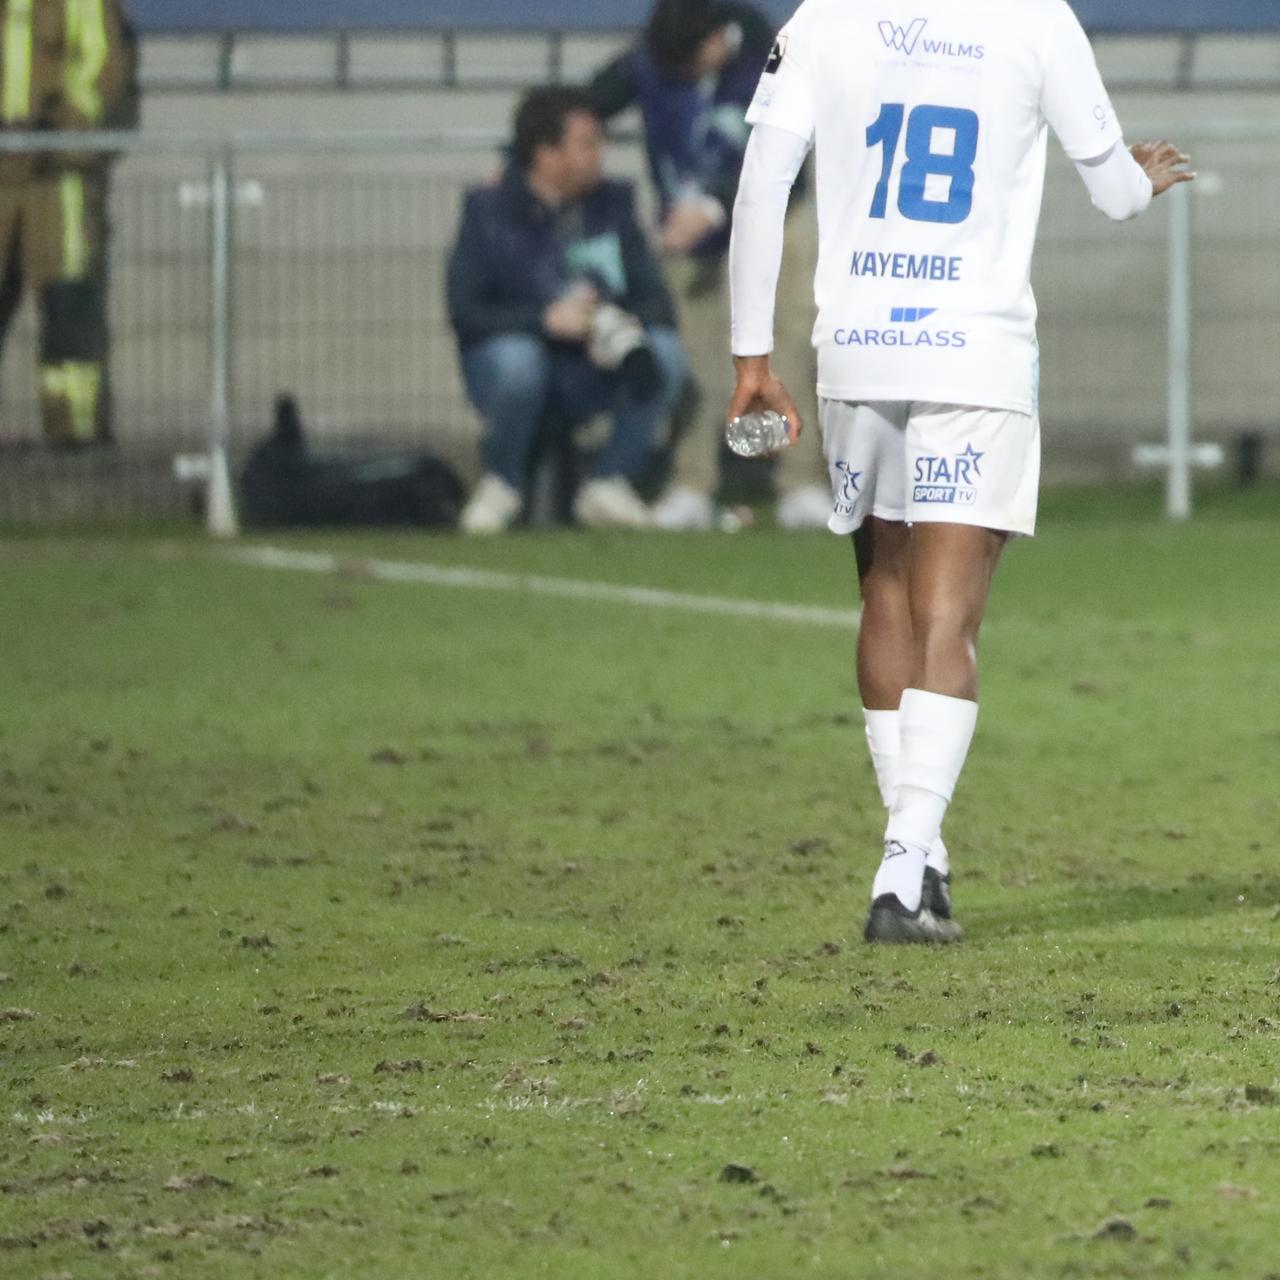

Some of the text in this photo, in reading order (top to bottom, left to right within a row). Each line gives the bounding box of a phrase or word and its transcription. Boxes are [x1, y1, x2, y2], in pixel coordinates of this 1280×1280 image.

[923, 38, 985, 59] WILMS
[866, 103, 979, 224] 18
[850, 251, 962, 281] KAYEMBE
[834, 329, 967, 348] CARGLASS
[914, 456, 973, 485] STAR
[915, 486, 974, 502] SPORT TV
